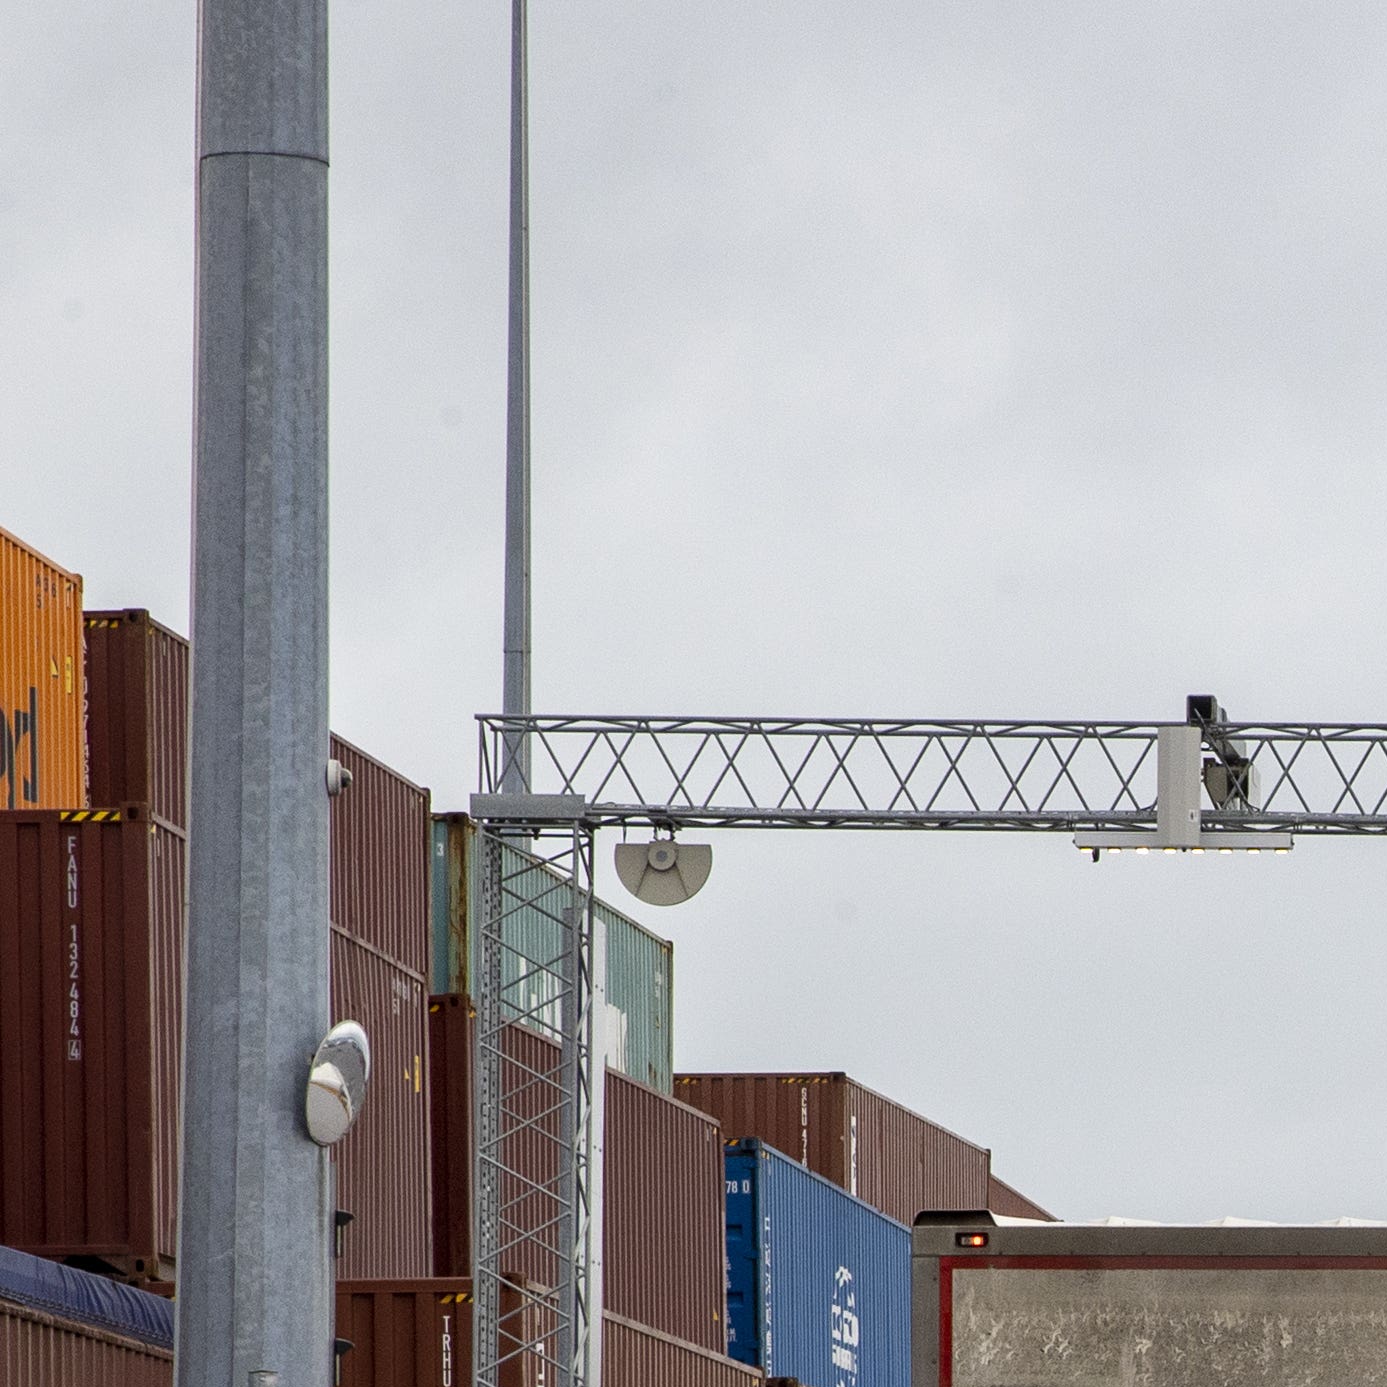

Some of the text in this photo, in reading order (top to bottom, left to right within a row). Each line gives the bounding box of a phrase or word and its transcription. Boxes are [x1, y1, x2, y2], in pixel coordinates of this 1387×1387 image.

[67, 836, 77, 909] FANU
[69, 924, 79, 1037] 132484
[442, 1315, 451, 1387] TRHU
